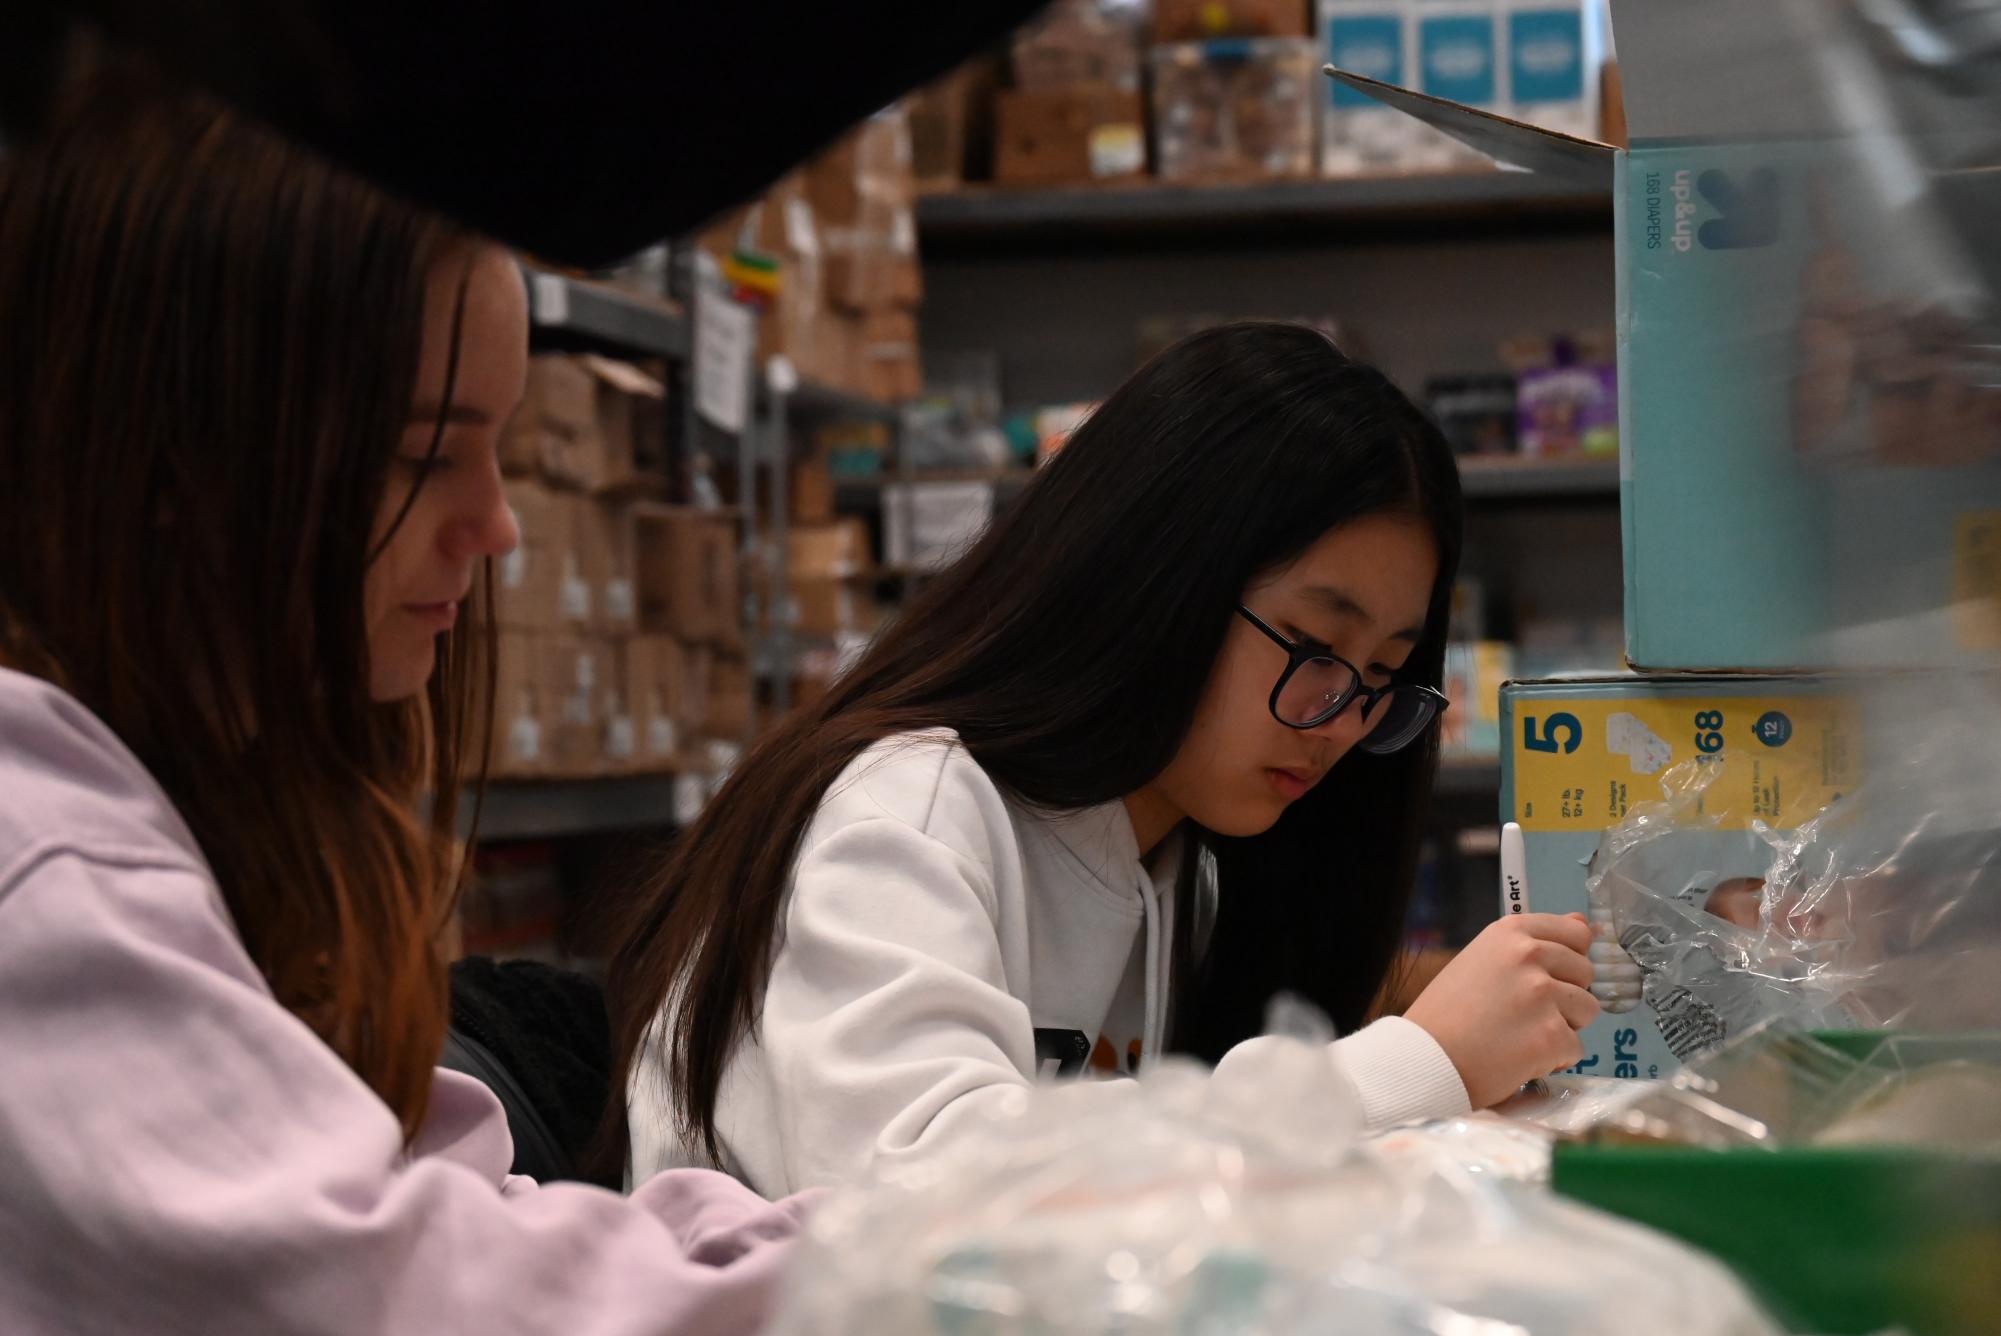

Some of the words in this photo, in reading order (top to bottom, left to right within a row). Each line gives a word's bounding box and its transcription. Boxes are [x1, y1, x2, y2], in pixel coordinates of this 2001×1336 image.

[1646, 172, 1661, 195] 168
[1670, 170, 1696, 252] up&up
[1647, 197, 1662, 250] DIAPERS
[1523, 712, 1583, 755] 5
[1764, 721, 1778, 738] 12
[1574, 789, 1584, 800] kg
[1609, 780, 1618, 811] Designs
[1562, 801, 1571, 817] 27+
[1574, 803, 1583, 817] 12+
[1508, 880, 1520, 901] Art
